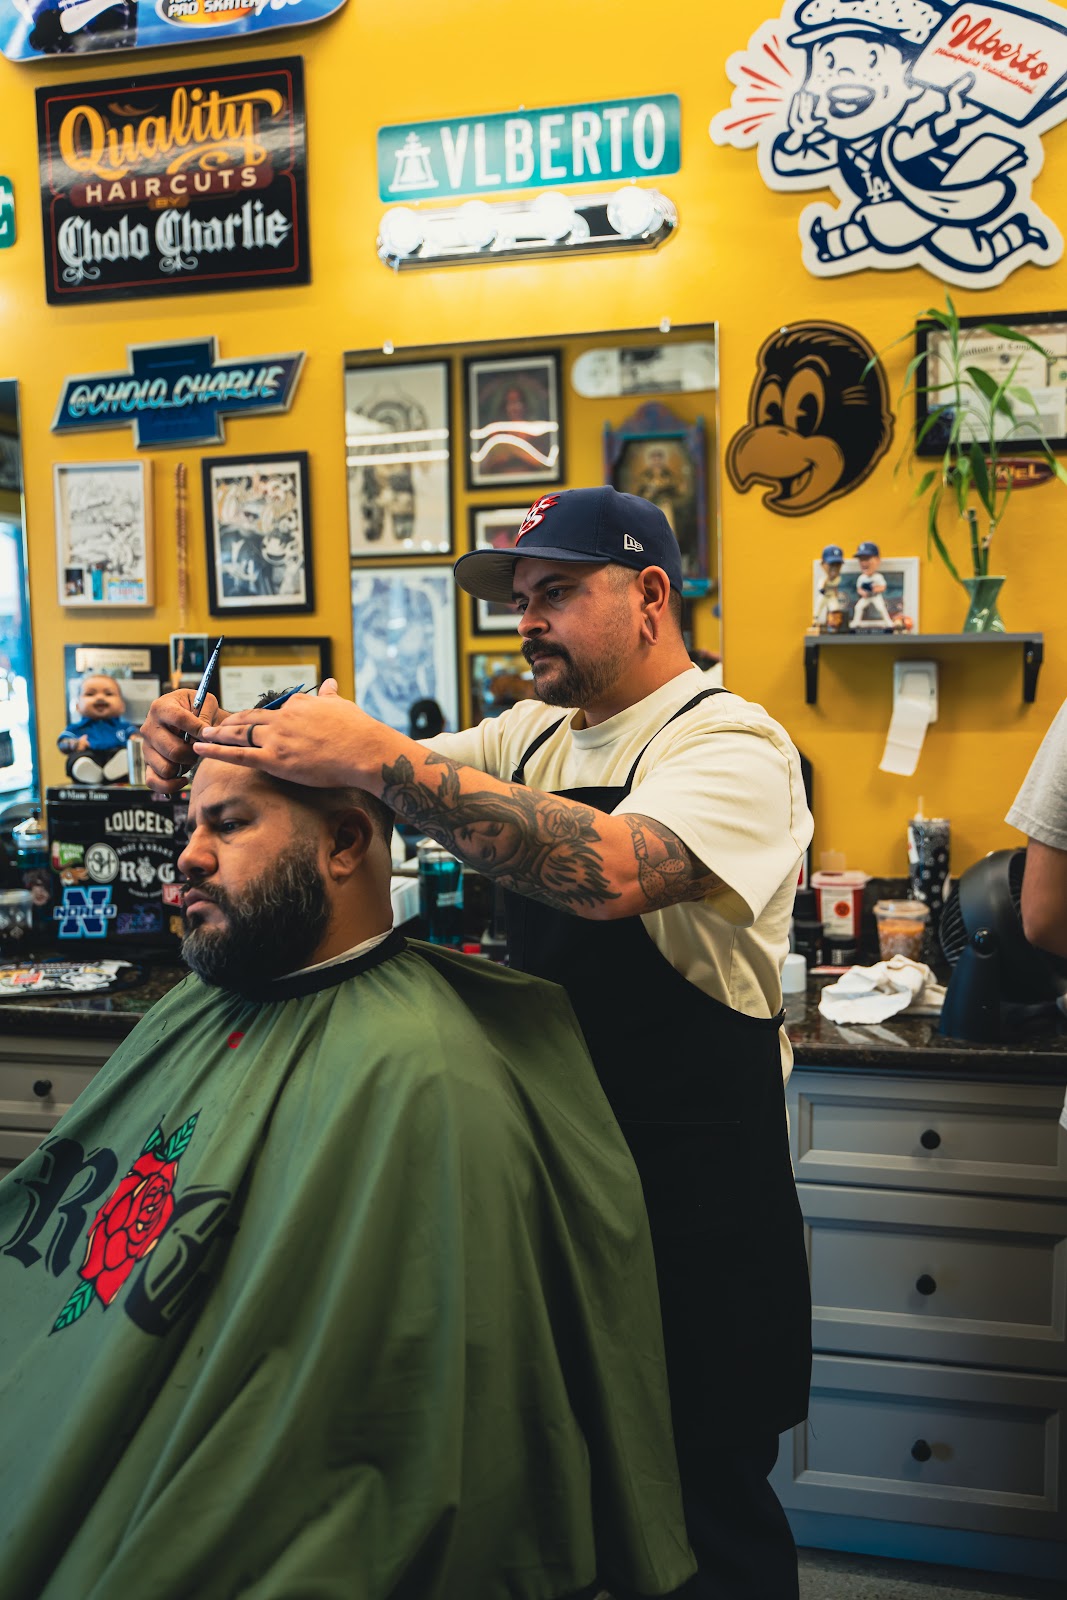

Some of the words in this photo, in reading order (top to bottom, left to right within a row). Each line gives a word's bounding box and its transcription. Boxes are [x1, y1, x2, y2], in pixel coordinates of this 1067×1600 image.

[167, 2, 199, 17] PRO
[59, 86, 284, 181] Quality
[85, 167, 258, 204] HAIRCUTS
[861, 171, 893, 203] LA
[154, 196, 181, 208] BY
[57, 214, 150, 285] Cholo
[154, 199, 293, 274] Charlie
[104, 809, 174, 834] LOUCEL'S
[53, 904, 117, 919] NORCO
